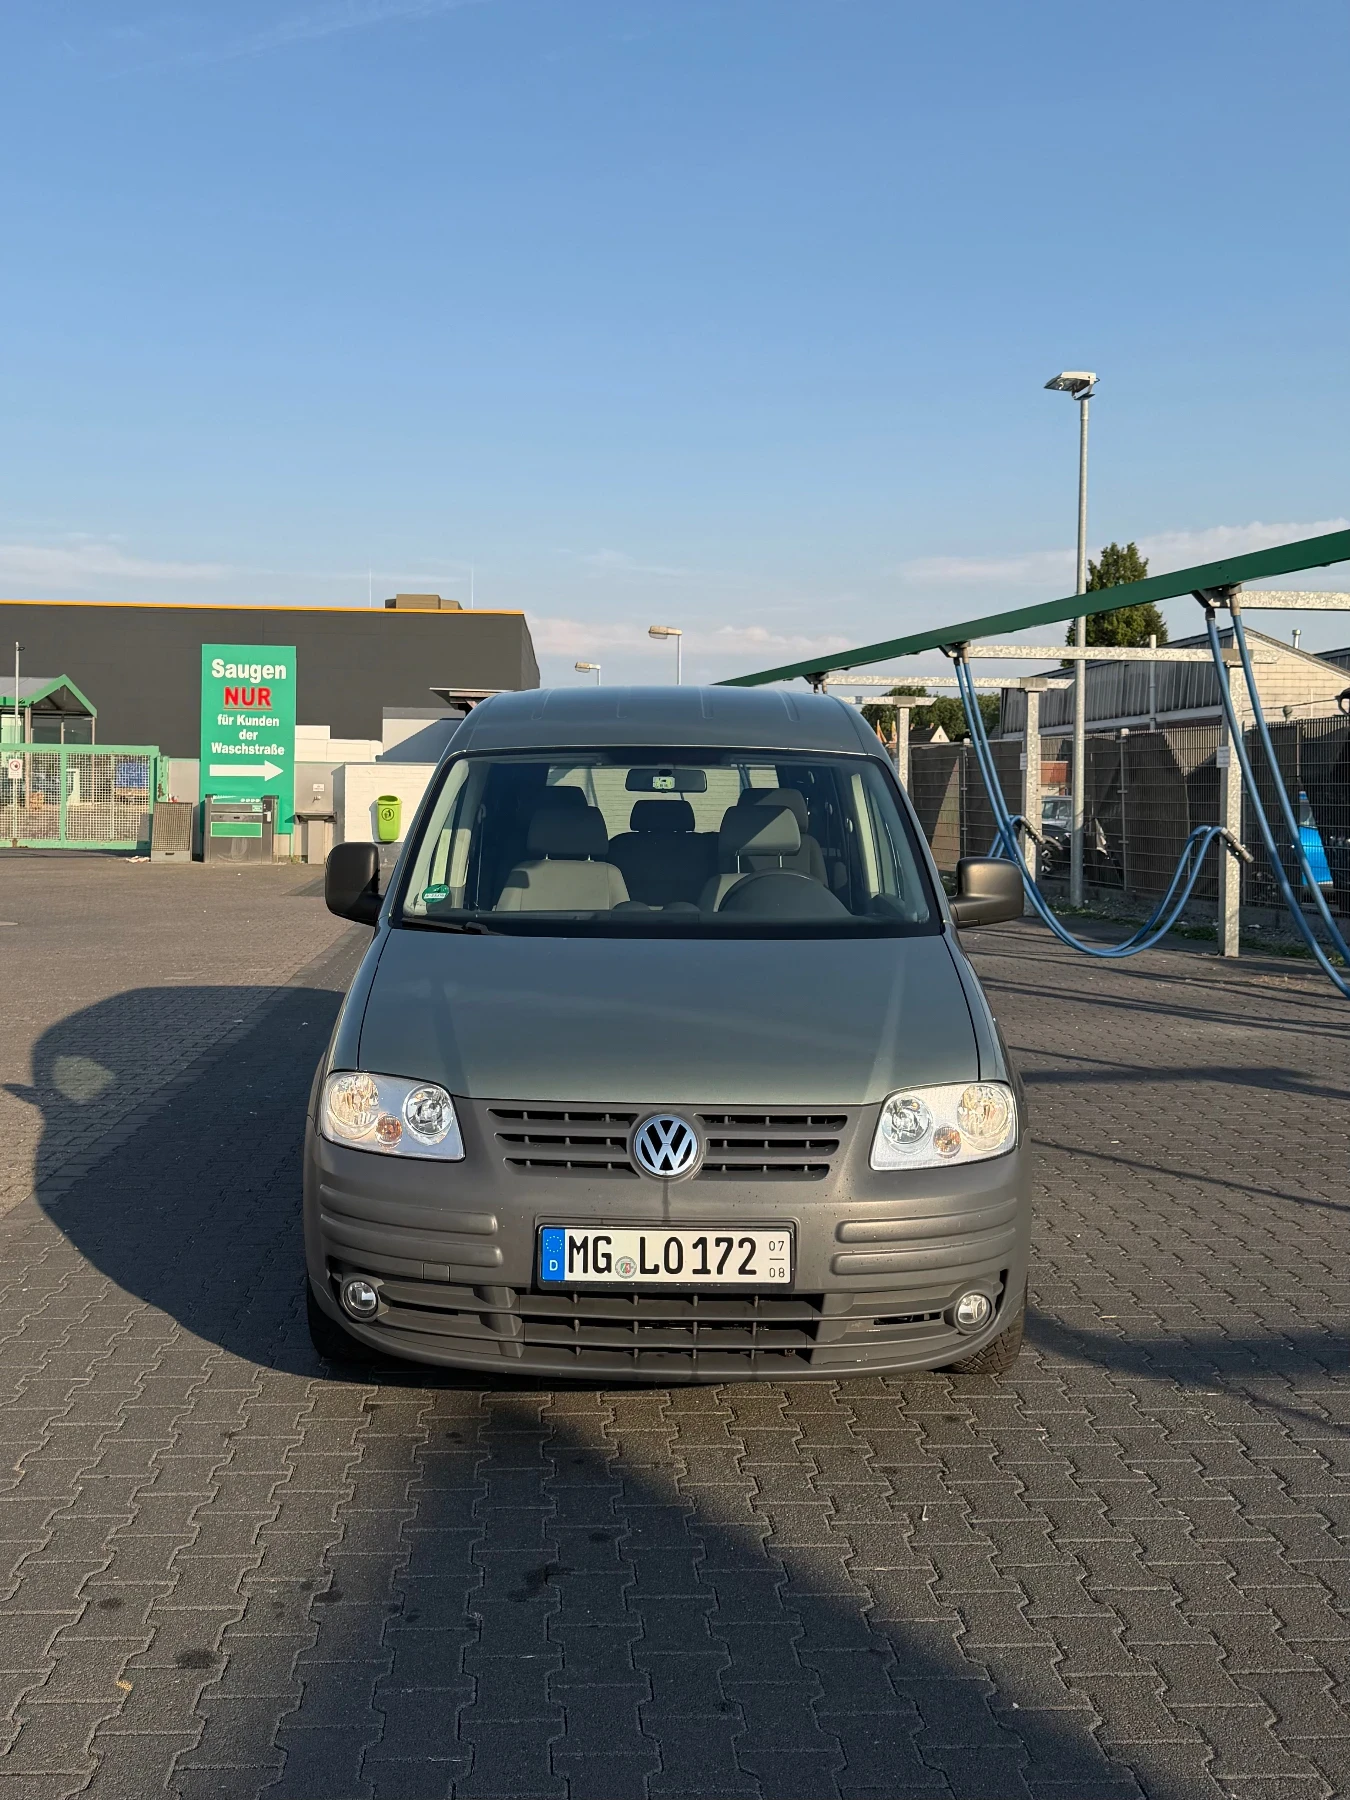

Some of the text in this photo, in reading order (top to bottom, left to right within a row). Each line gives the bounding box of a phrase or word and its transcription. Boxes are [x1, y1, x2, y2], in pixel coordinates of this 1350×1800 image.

[212, 658, 287, 684] Saugen
[223, 685, 272, 707] NUR
[217, 713, 280, 727] für Kunden
[239, 729, 259, 740] der
[211, 742, 285, 756] Waschstraße
[636, 1115, 698, 1176] VW
[768, 1240, 785, 1252] 07
[567, 1235, 612, 1274] MG
[549, 1259, 559, 1272] D
[768, 1267, 785, 1278] 08
